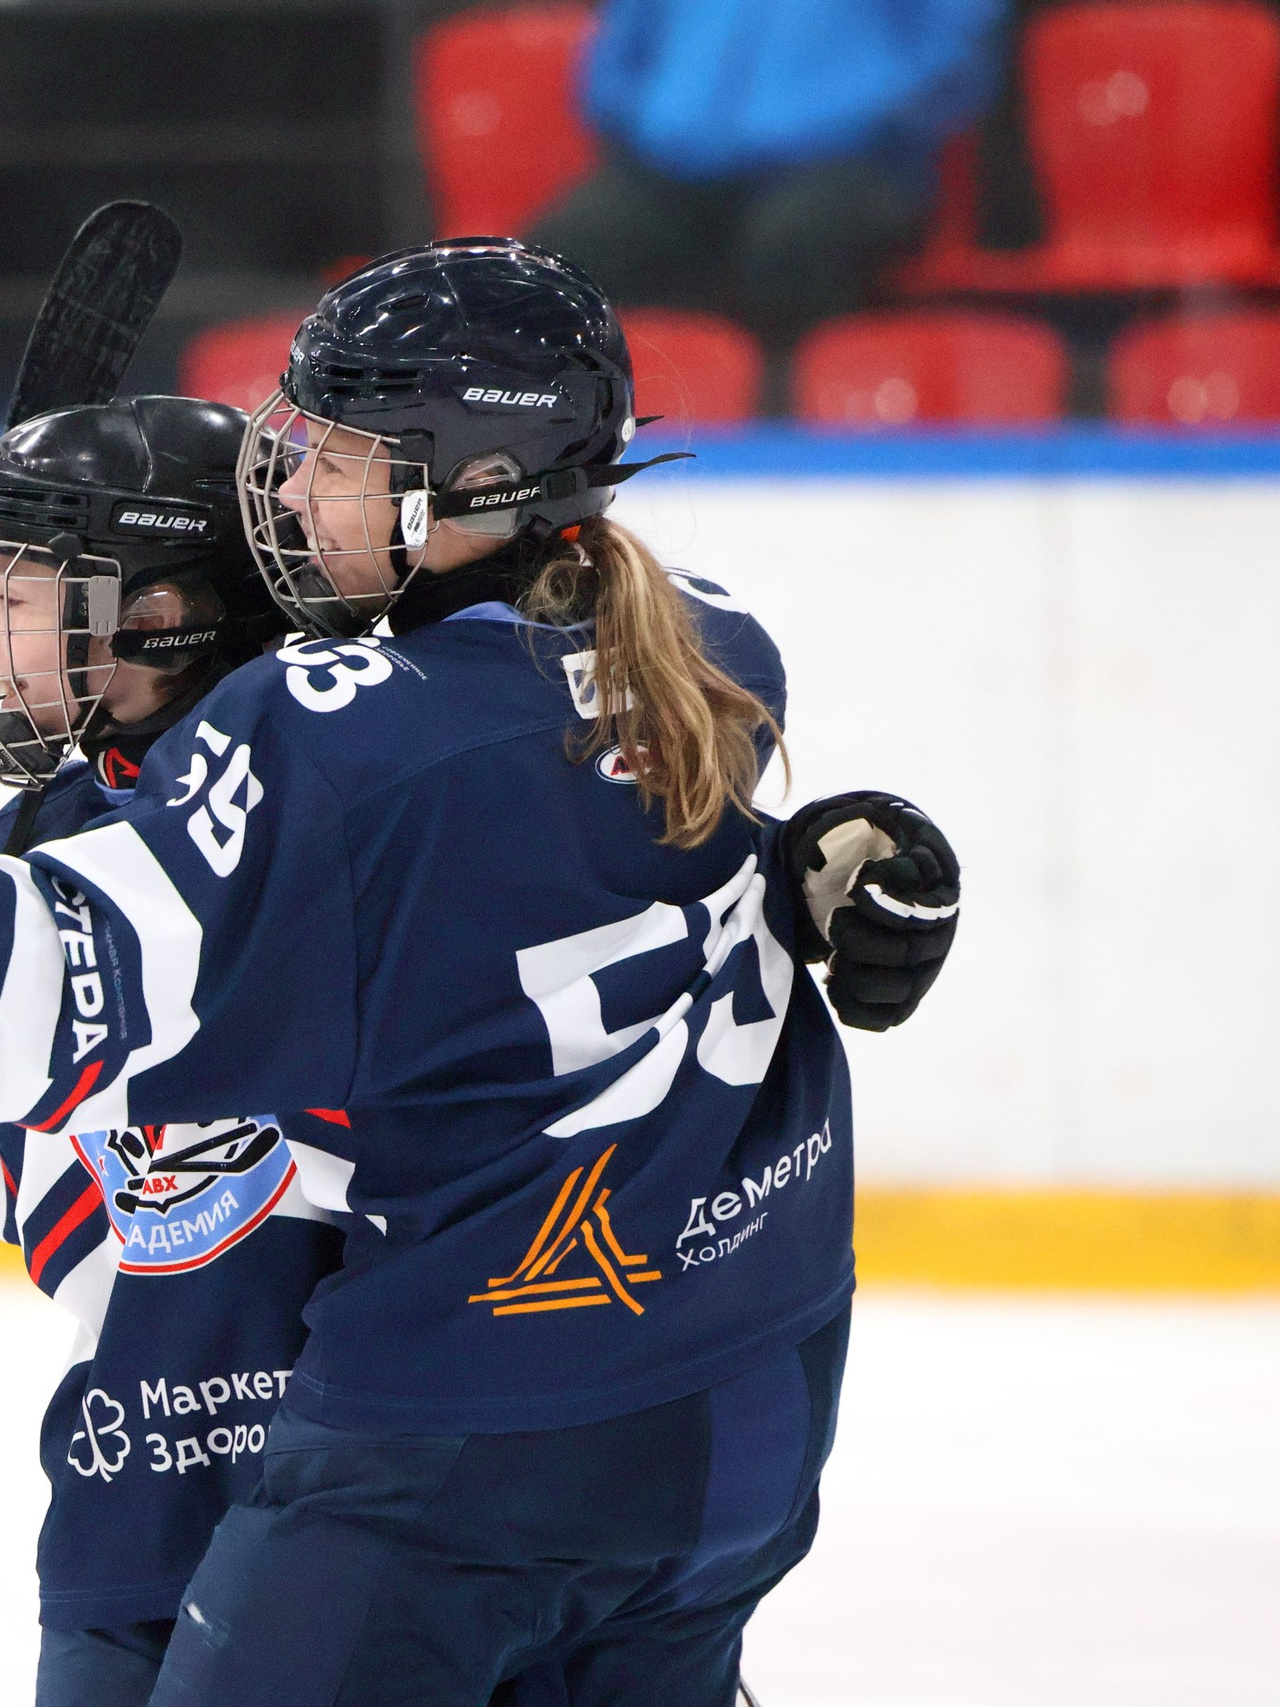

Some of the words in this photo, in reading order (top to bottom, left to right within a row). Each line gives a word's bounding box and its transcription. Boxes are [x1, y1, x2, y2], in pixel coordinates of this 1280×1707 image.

[462, 387, 558, 408] BAUER
[118, 511, 208, 532] BAUER
[406, 497, 423, 531] BAUER
[142, 630, 217, 649] BAUER
[141, 1174, 179, 1195] АВХ
[126, 1189, 240, 1255] АДЕМИЯ
[676, 1211, 769, 1272] Холдинг
[140, 1369, 294, 1420] Маркет
[145, 1423, 272, 1475] Здоро
